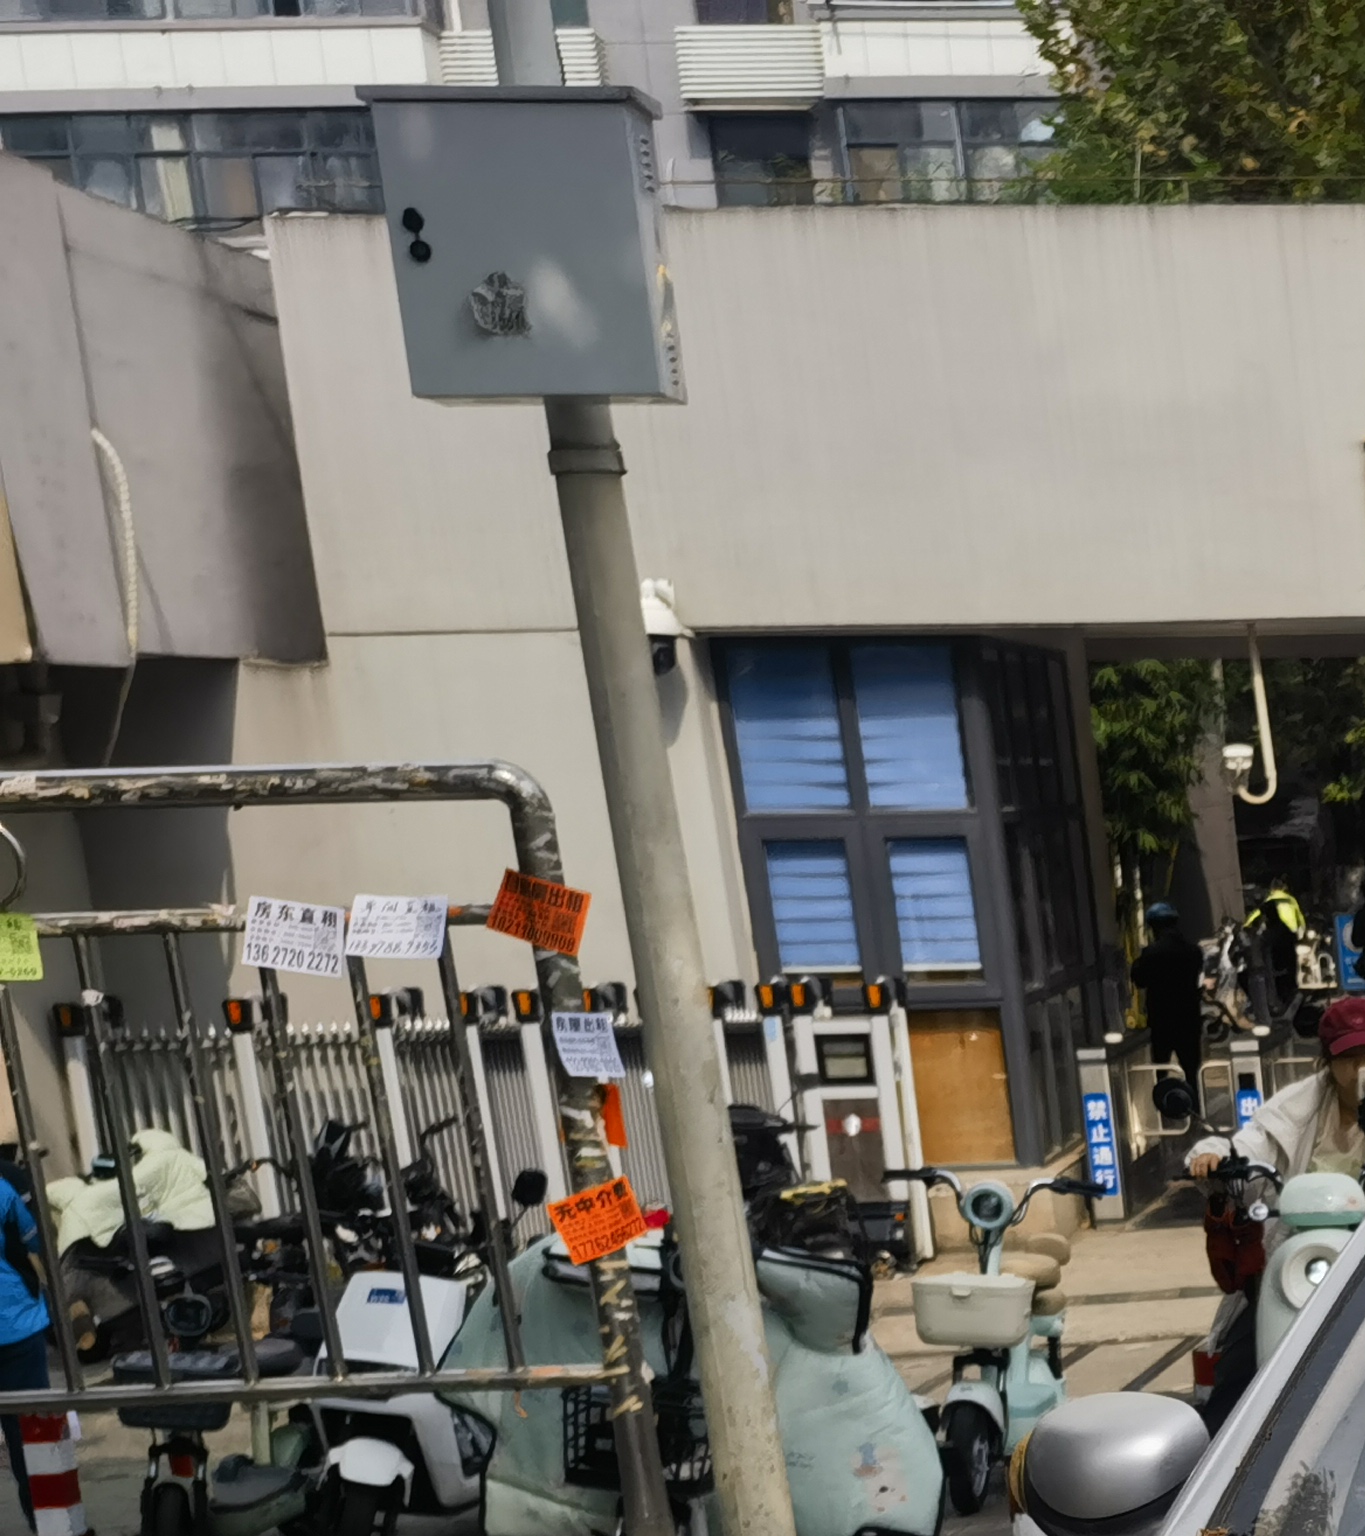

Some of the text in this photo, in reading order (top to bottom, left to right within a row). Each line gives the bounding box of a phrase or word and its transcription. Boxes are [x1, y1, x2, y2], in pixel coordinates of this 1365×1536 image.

[254, 901, 338, 928] 房东直租
[246, 942, 340, 974] 136 2720 2272
[1086, 1100, 1117, 1190] 禁止通行
